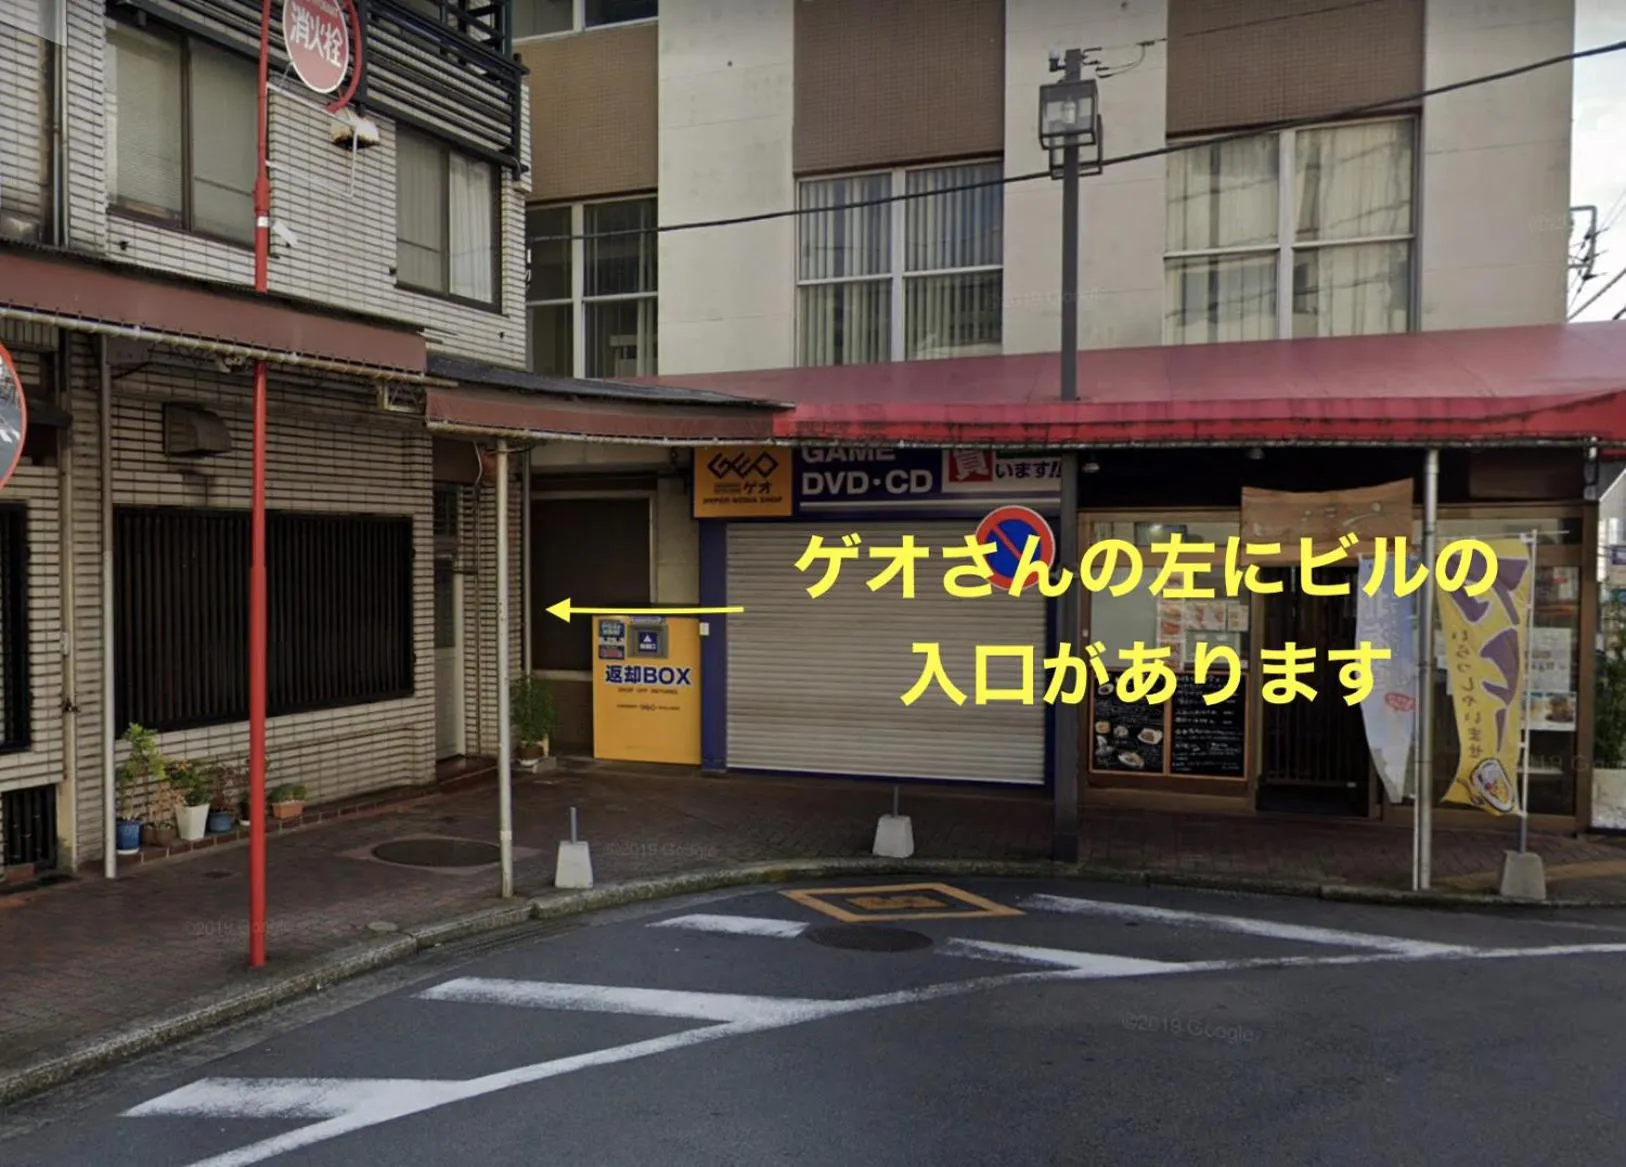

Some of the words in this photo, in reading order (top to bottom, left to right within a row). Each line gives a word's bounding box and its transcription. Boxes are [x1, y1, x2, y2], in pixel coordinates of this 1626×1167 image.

[289, 1, 343, 68] 消火栓
[706, 450, 779, 480] GEO
[742, 481, 773, 495] ゲオ
[605, 664, 691, 685] 返却BOX
